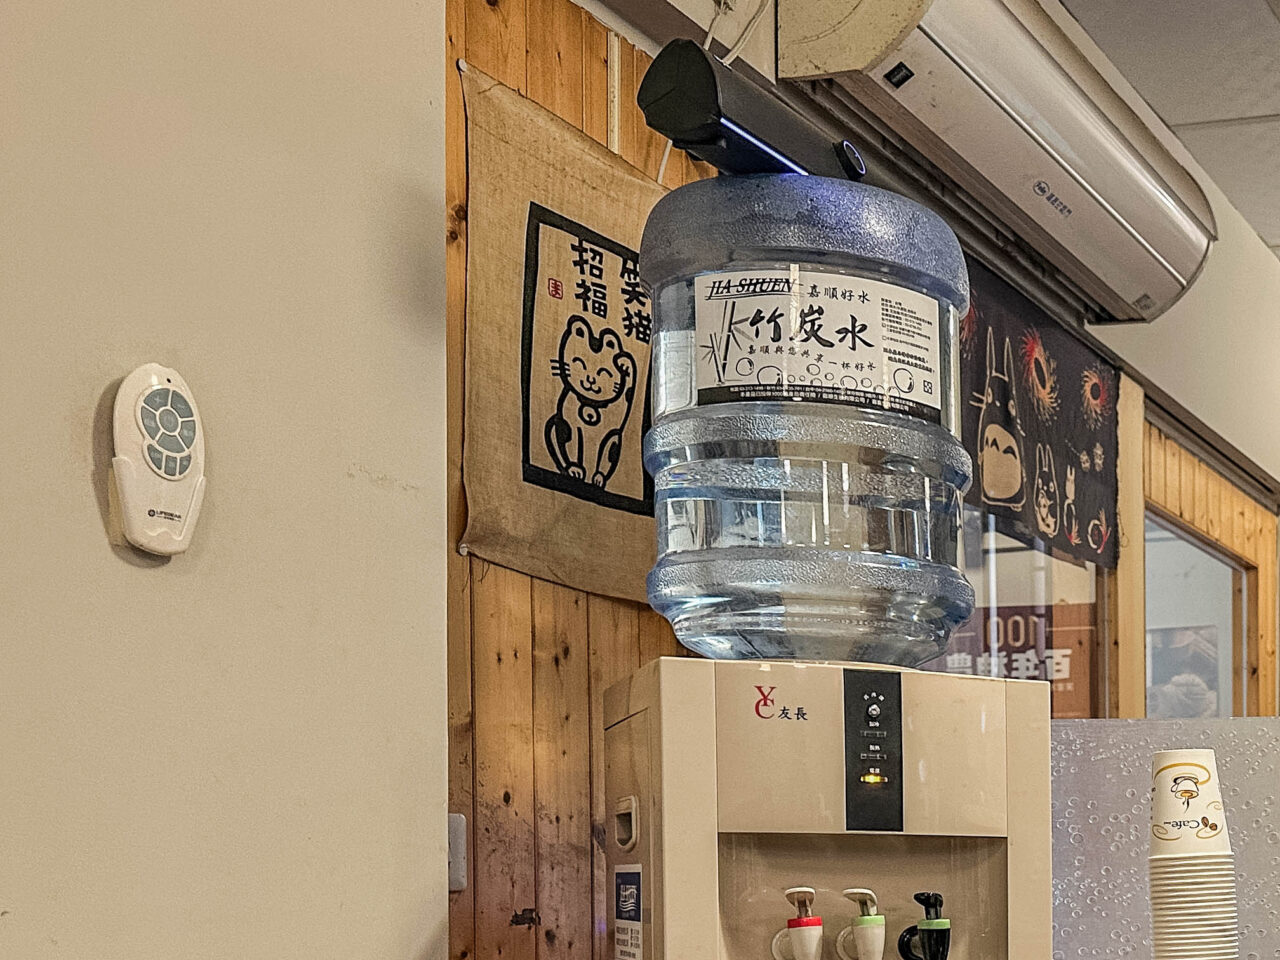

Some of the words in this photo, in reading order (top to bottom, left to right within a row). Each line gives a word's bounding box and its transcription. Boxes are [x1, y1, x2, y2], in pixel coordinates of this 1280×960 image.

[570, 239, 608, 320] 招福
[706, 280, 732, 301] JIA
[736, 278, 796, 294] SHUEN
[807, 284, 871, 304] 嘉順好水
[749, 303, 875, 351] 竹炭水
[778, 706, 808, 720] 友長
